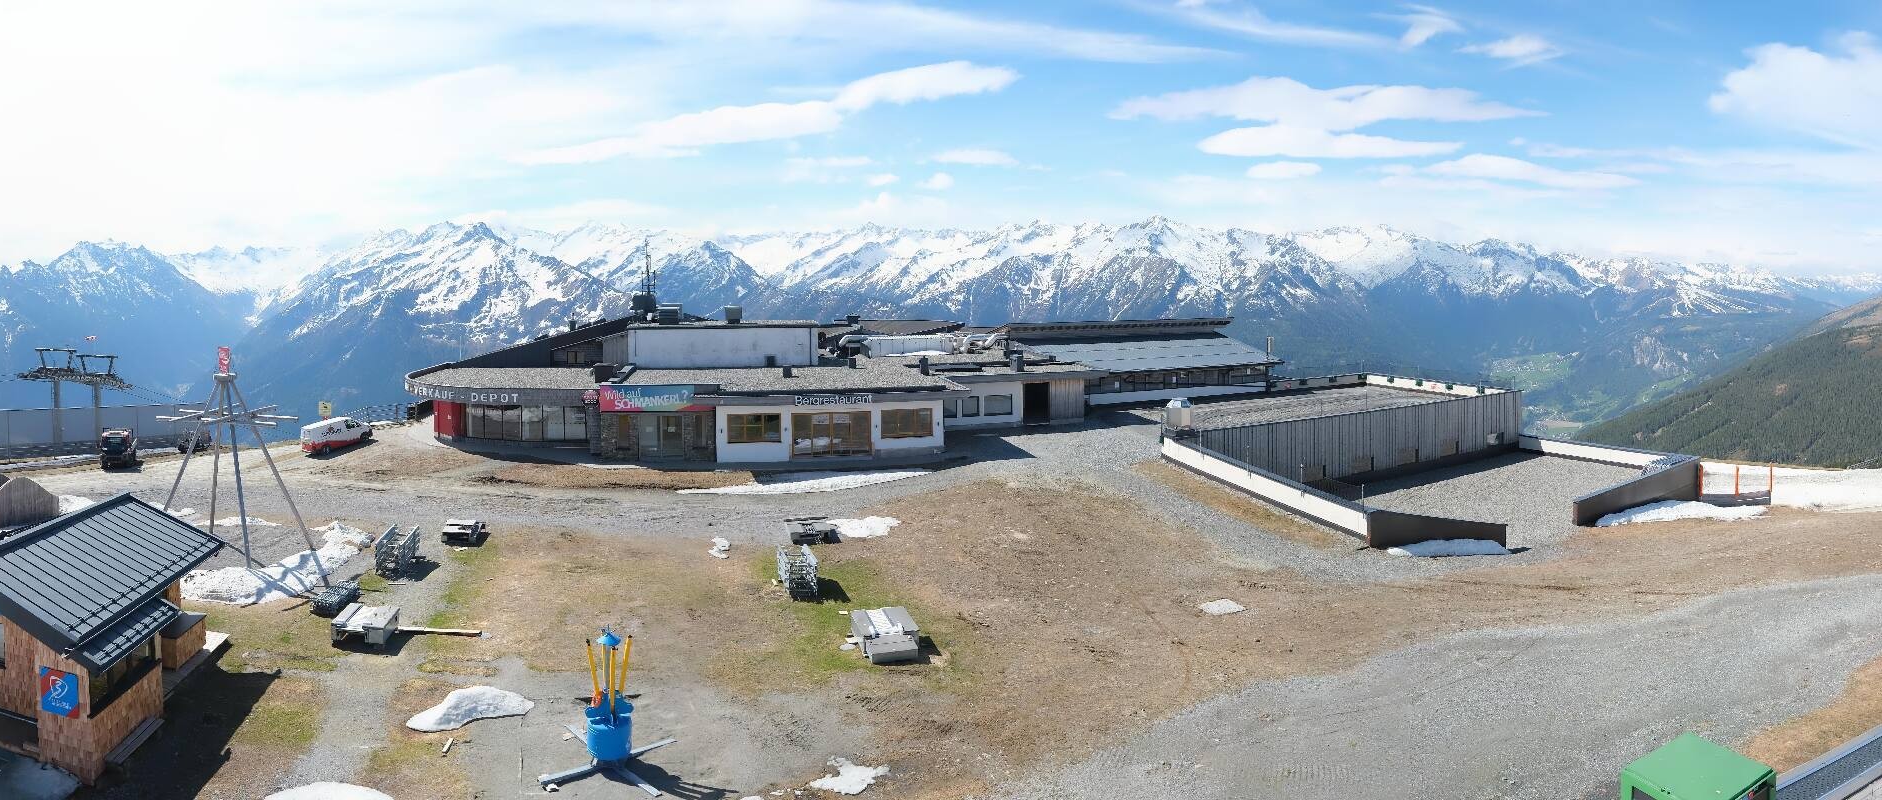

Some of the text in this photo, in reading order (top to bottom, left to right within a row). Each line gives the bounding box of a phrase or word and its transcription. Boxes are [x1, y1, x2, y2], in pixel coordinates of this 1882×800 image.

[414, 385, 455, 400] VERKAUF
[471, 393, 519, 403] DEPOT
[604, 387, 642, 400] Wild auf
[795, 394, 873, 406] Bergrestaurant
